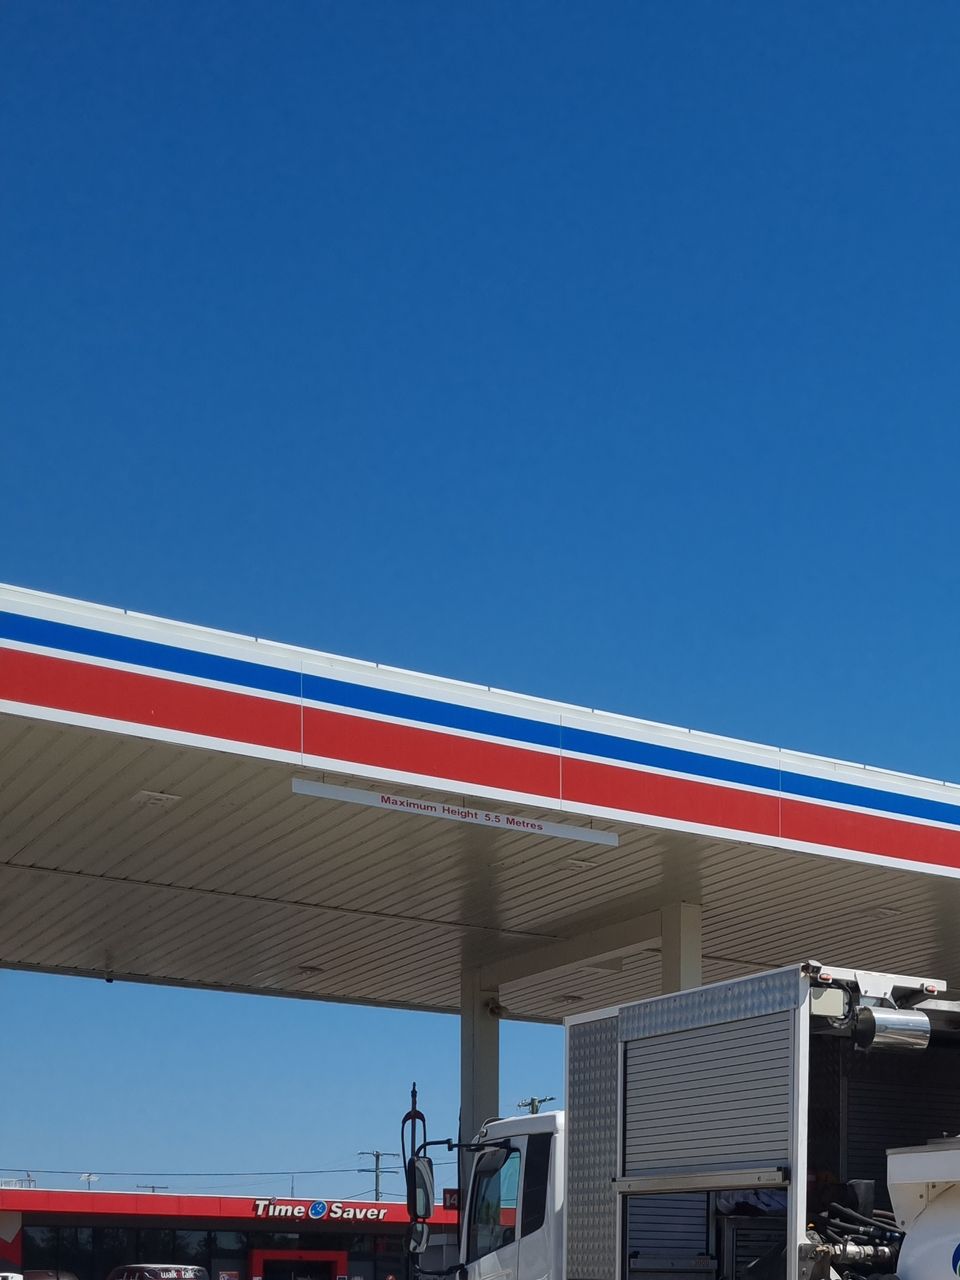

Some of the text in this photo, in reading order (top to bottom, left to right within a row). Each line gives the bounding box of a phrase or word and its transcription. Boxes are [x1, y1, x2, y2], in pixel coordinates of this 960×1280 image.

[380, 795, 543, 831] Maximum Height 5.5 Metres
[255, 1200, 388, 1220] Time Saver
[445, 1193, 458, 1207] 14
